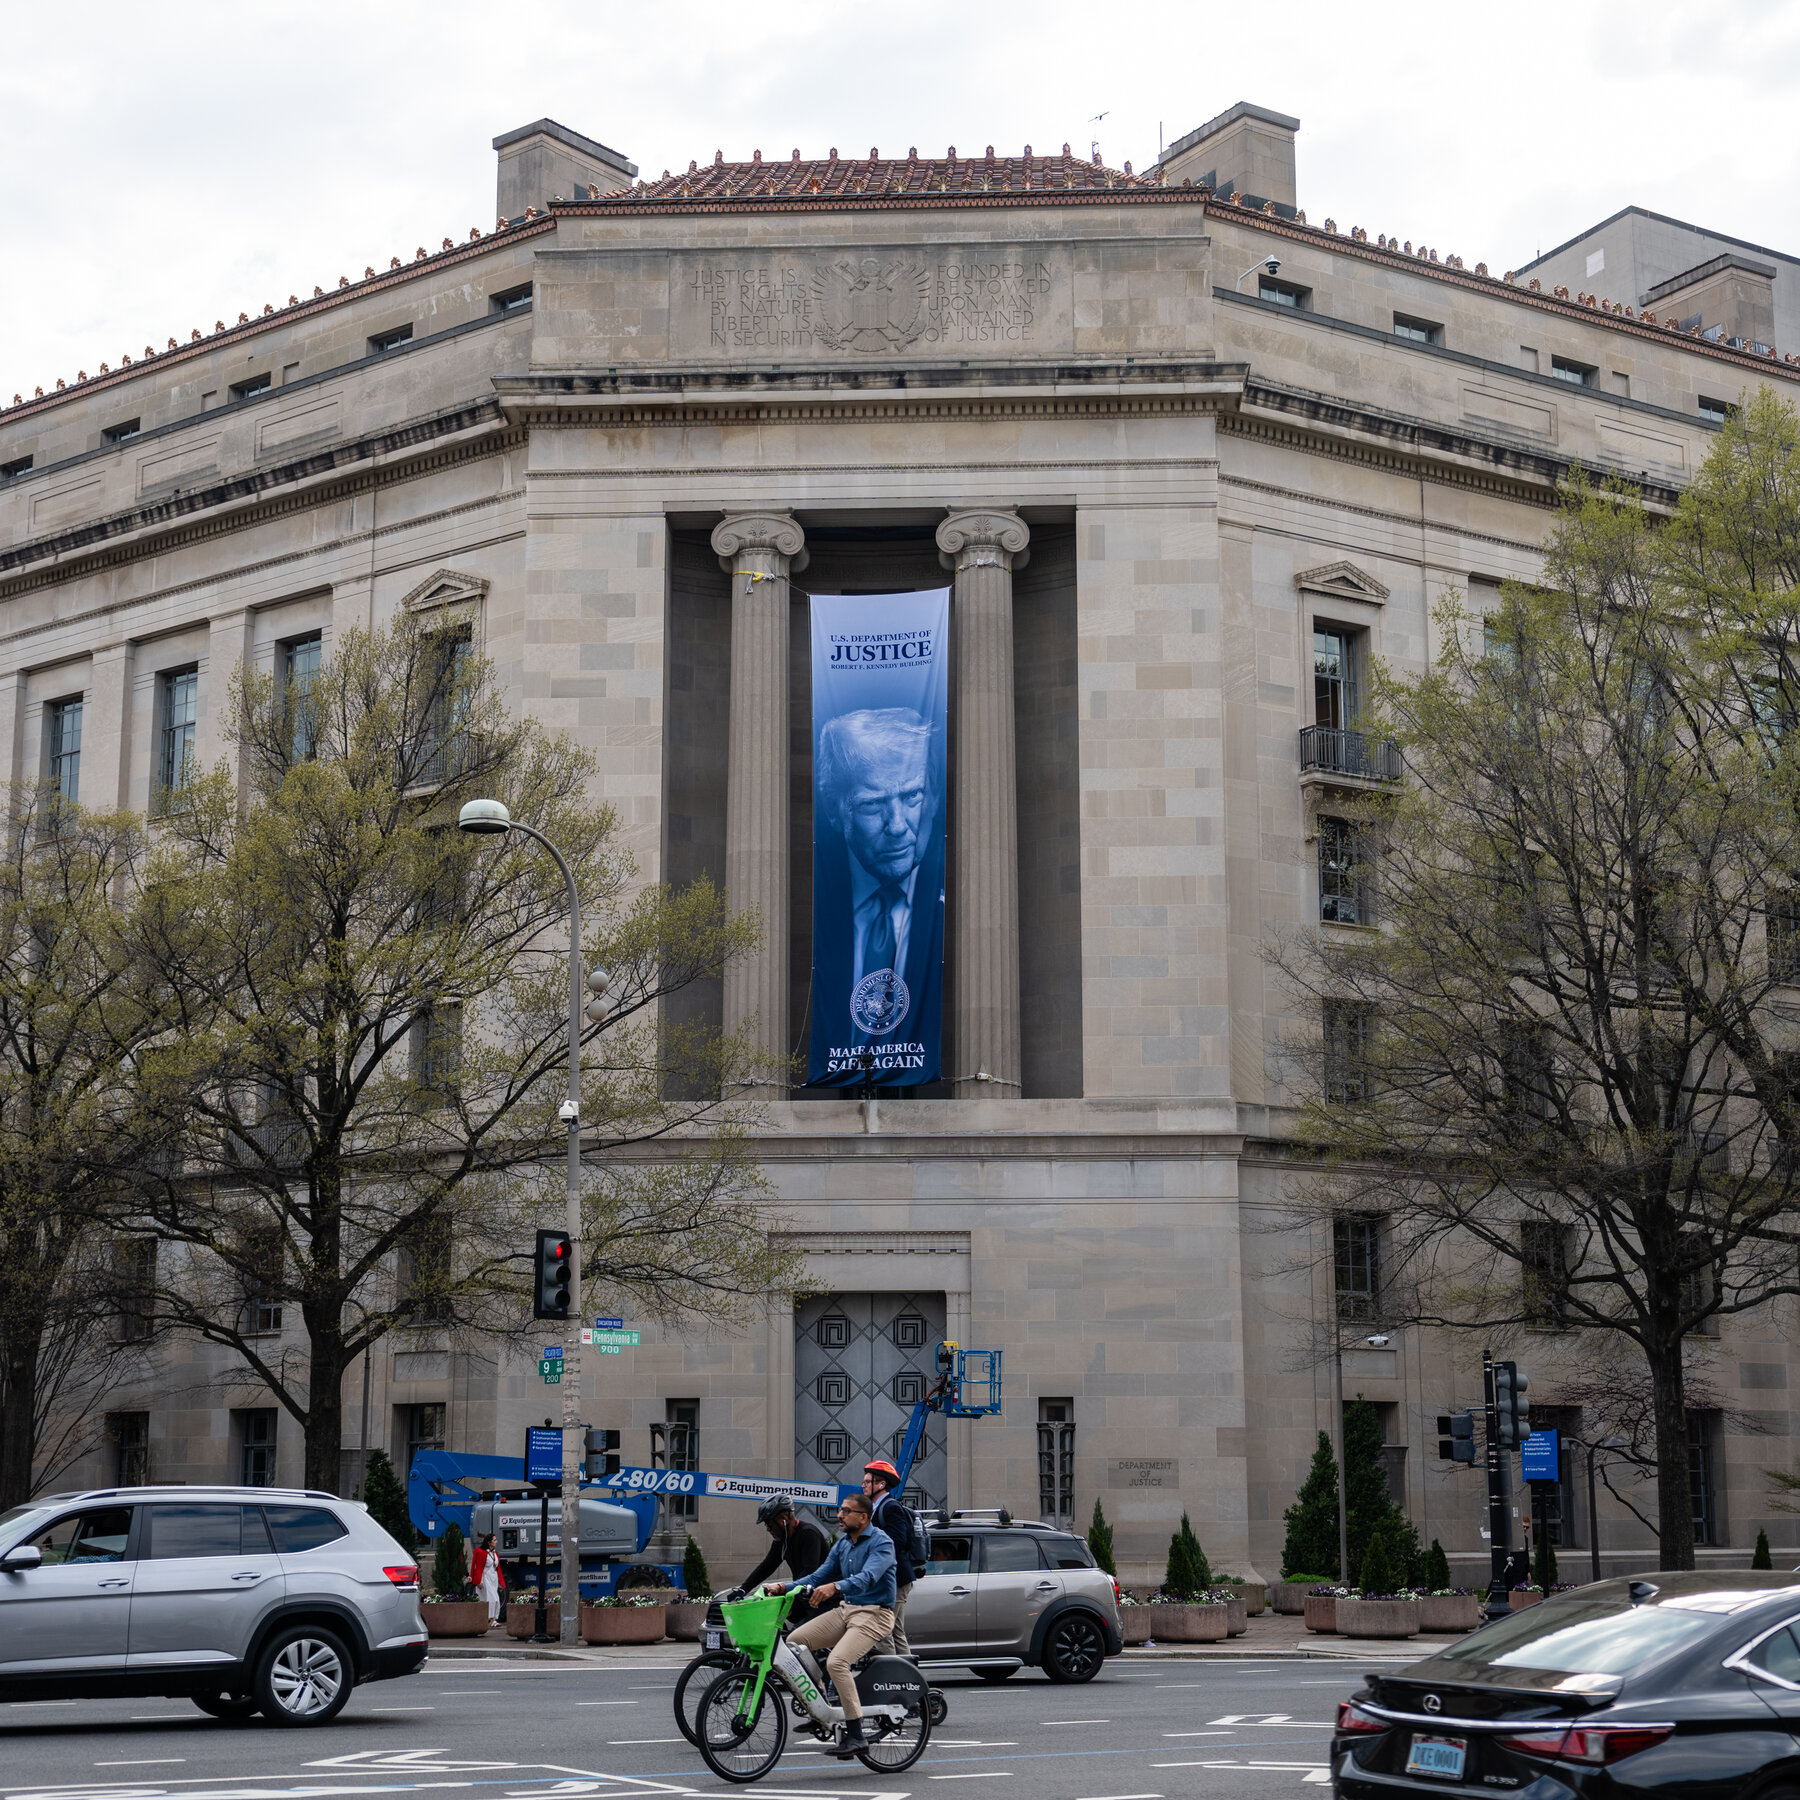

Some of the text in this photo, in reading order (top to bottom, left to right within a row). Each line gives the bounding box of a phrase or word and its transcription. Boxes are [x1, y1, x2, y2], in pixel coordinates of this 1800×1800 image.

[689, 268, 796, 286] JUSTICE IS
[937, 262, 1052, 280] FOUNDED IN
[691, 284, 807, 301] THE RIGHTS
[936, 279, 1051, 296] BESTOWED
[711, 300, 814, 316] BY NATURE
[927, 294, 1035, 311] UPON MAN.
[710, 315, 811, 332] LIBERTY IS
[928, 310, 1034, 327] MAINTAINED
[710, 330, 818, 347] IN SECURITY
[925, 325, 1035, 343] OF JUSTICE.
[830, 629, 932, 643] U.S. DEPARTMENT OF
[830, 640, 932, 662] JUSTICE
[866, 662, 899, 670] KENNEDY
[899, 658, 933, 668] BUILDING
[829, 1042, 925, 1058] MAKE AMERICA
[871, 1055, 926, 1069] AGAIN
[593, 1330, 631, 1345] Pennsylvania
[601, 1345, 619, 1354] 900
[543, 1361, 550, 1374] 9
[546, 1374, 559, 1383] 200
[1118, 1461, 1172, 1470] DEPARTMENT
[1140, 1470, 1151, 1478] OF
[1128, 1478, 1163, 1487] JUSTICE
[586, 1527, 616, 1537] Genie
[873, 1682, 884, 1691] On
[884, 1682, 901, 1691] Lime
[906, 1682, 920, 1691] Uber
